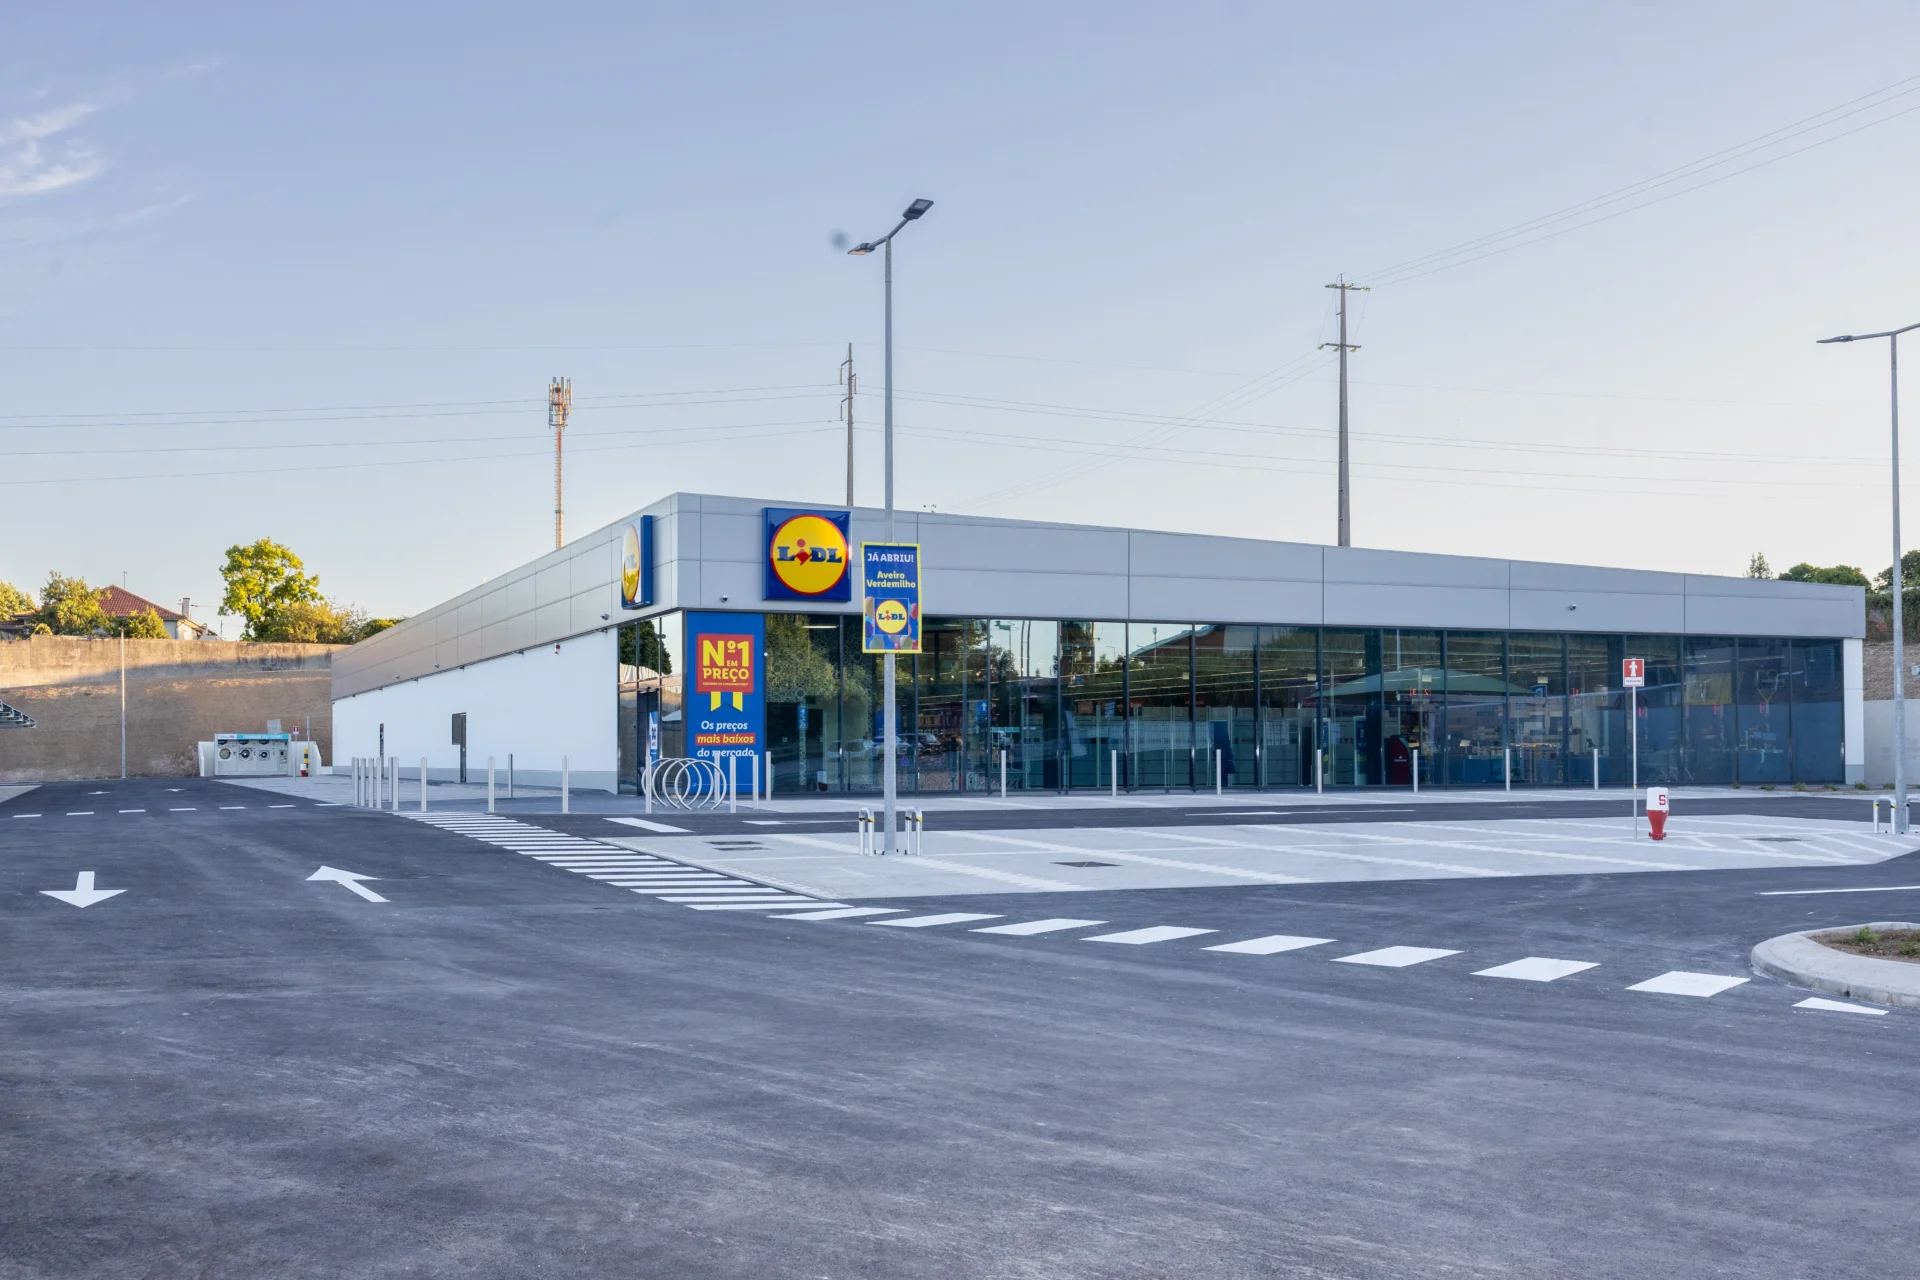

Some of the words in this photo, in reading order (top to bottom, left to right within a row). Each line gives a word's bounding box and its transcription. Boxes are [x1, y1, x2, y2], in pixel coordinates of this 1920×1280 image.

[867, 552, 879, 562] JÁ
[880, 553, 914, 563] ABRIU!
[877, 570, 905, 580] Aveiro
[866, 579, 916, 588] Verdemilho
[703, 667, 749, 682] PREÇO
[701, 720, 714, 730] Os
[716, 722, 748, 732] preços
[697, 734, 721, 744] mais
[723, 734, 754, 744] baixos
[697, 748, 710, 757] do
[1658, 794, 1668, 806] S
